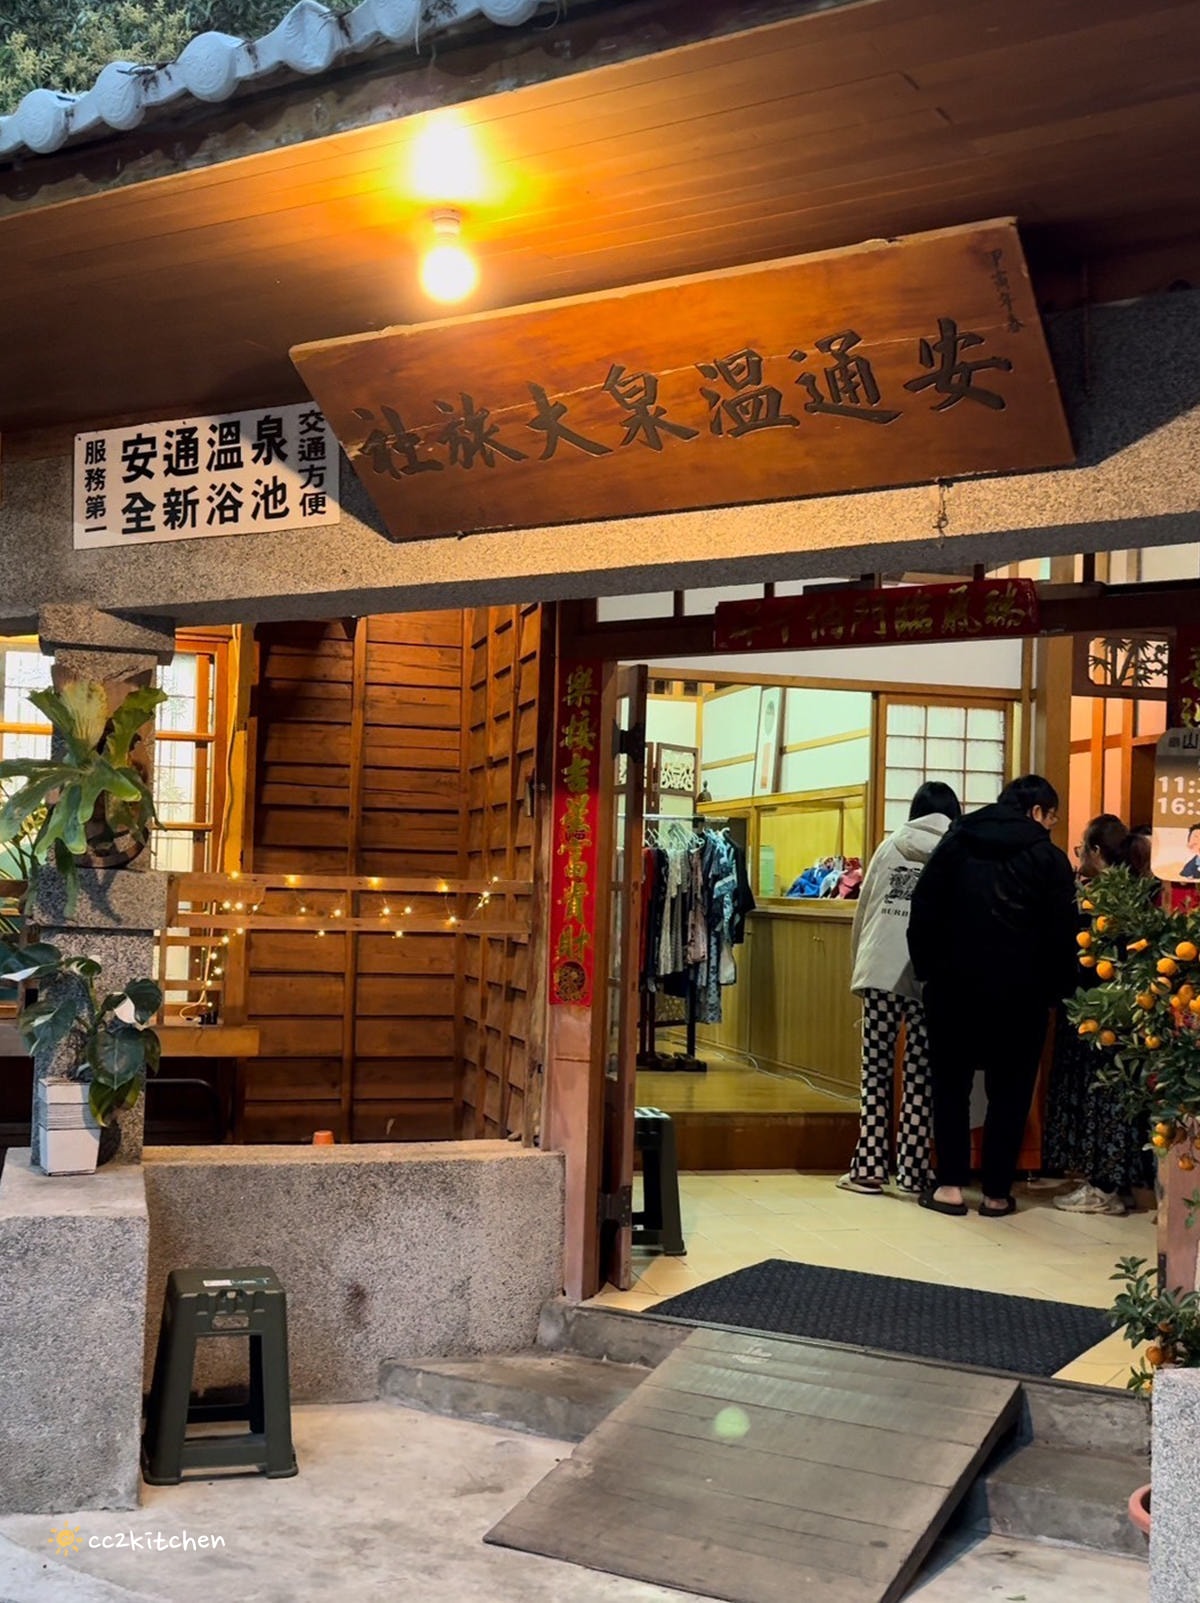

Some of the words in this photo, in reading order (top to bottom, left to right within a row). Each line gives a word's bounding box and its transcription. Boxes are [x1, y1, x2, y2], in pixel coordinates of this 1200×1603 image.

[84, 438, 107, 533] 服務第一
[121, 415, 288, 483] 安通溫泉
[298, 409, 327, 517] 交通方便
[121, 475, 290, 534] 全新浴池
